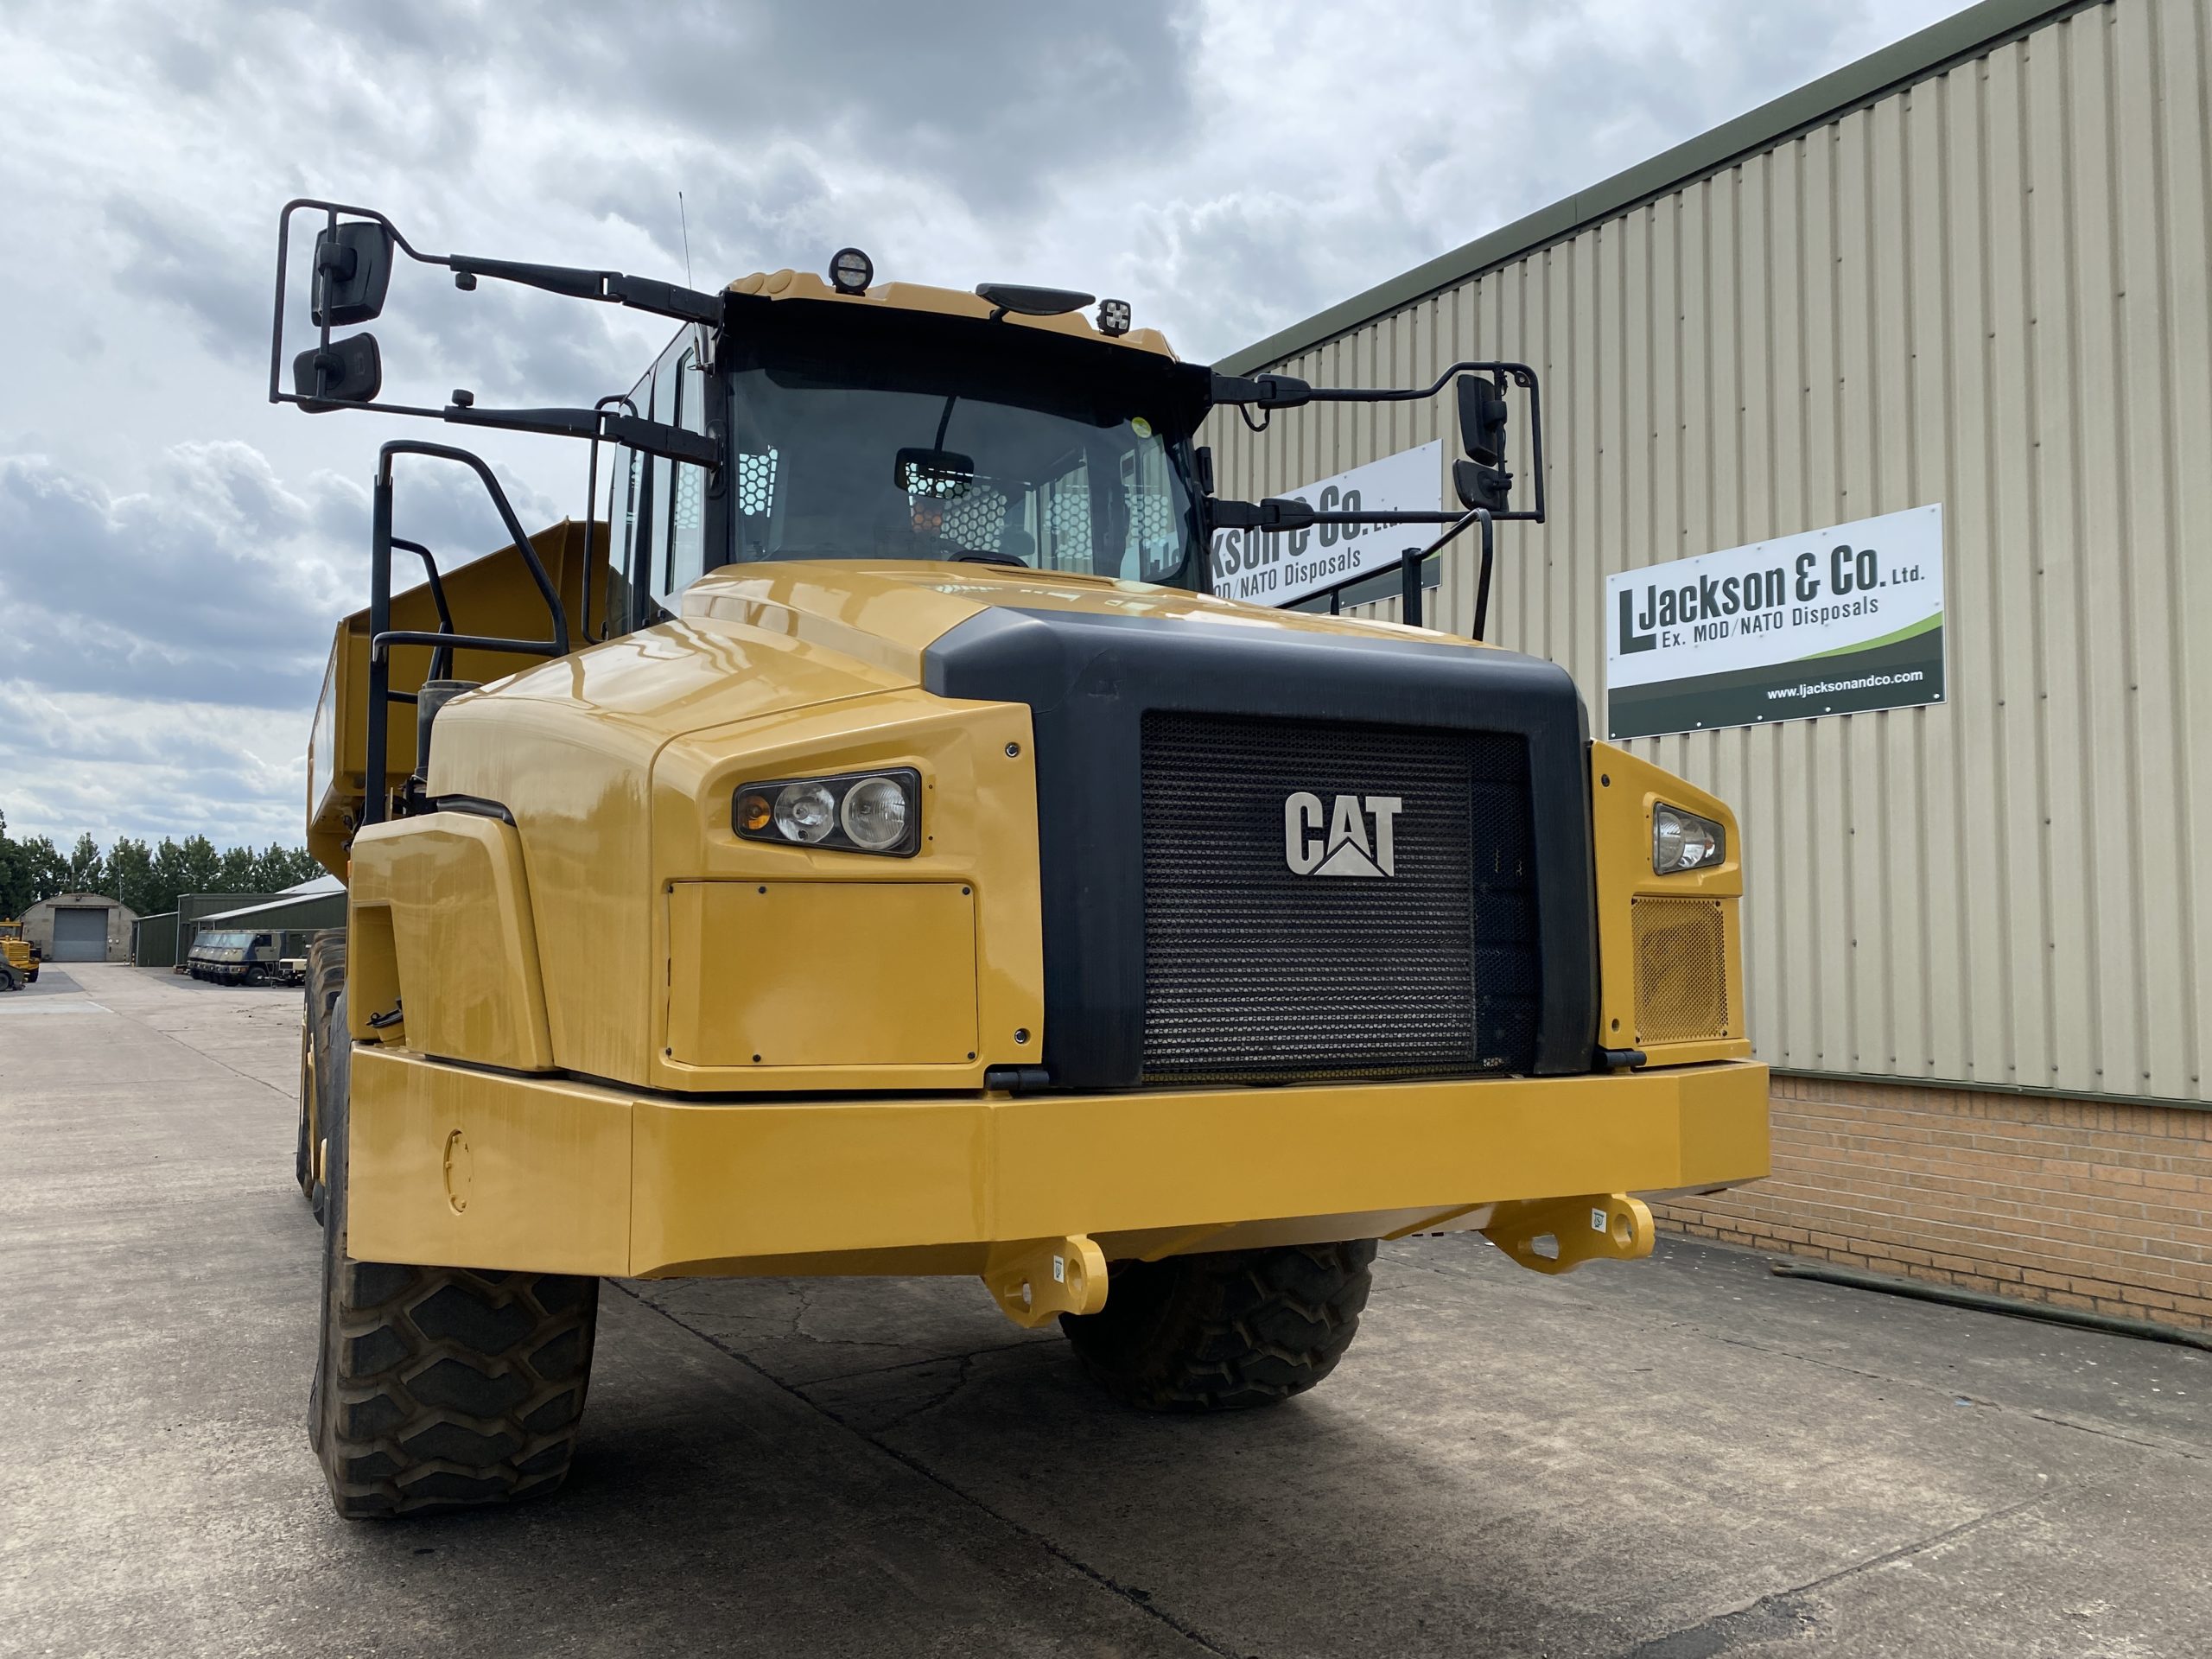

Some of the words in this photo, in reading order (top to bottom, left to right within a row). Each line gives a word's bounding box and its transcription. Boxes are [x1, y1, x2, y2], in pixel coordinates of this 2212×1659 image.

[1285, 547, 1361, 589] Disposals
[1796, 552, 1821, 601] &
[1830, 544, 1886, 596] Co.
[1892, 564, 1925, 586] Ltd.
[1662, 630, 1686, 648] Ex.
[1694, 610, 1783, 643] MOD/NATO
[1792, 595, 1879, 626] Disposals
[1767, 671, 1923, 699] www.ljacksonandco.com
[1285, 791, 1402, 877] CAT
